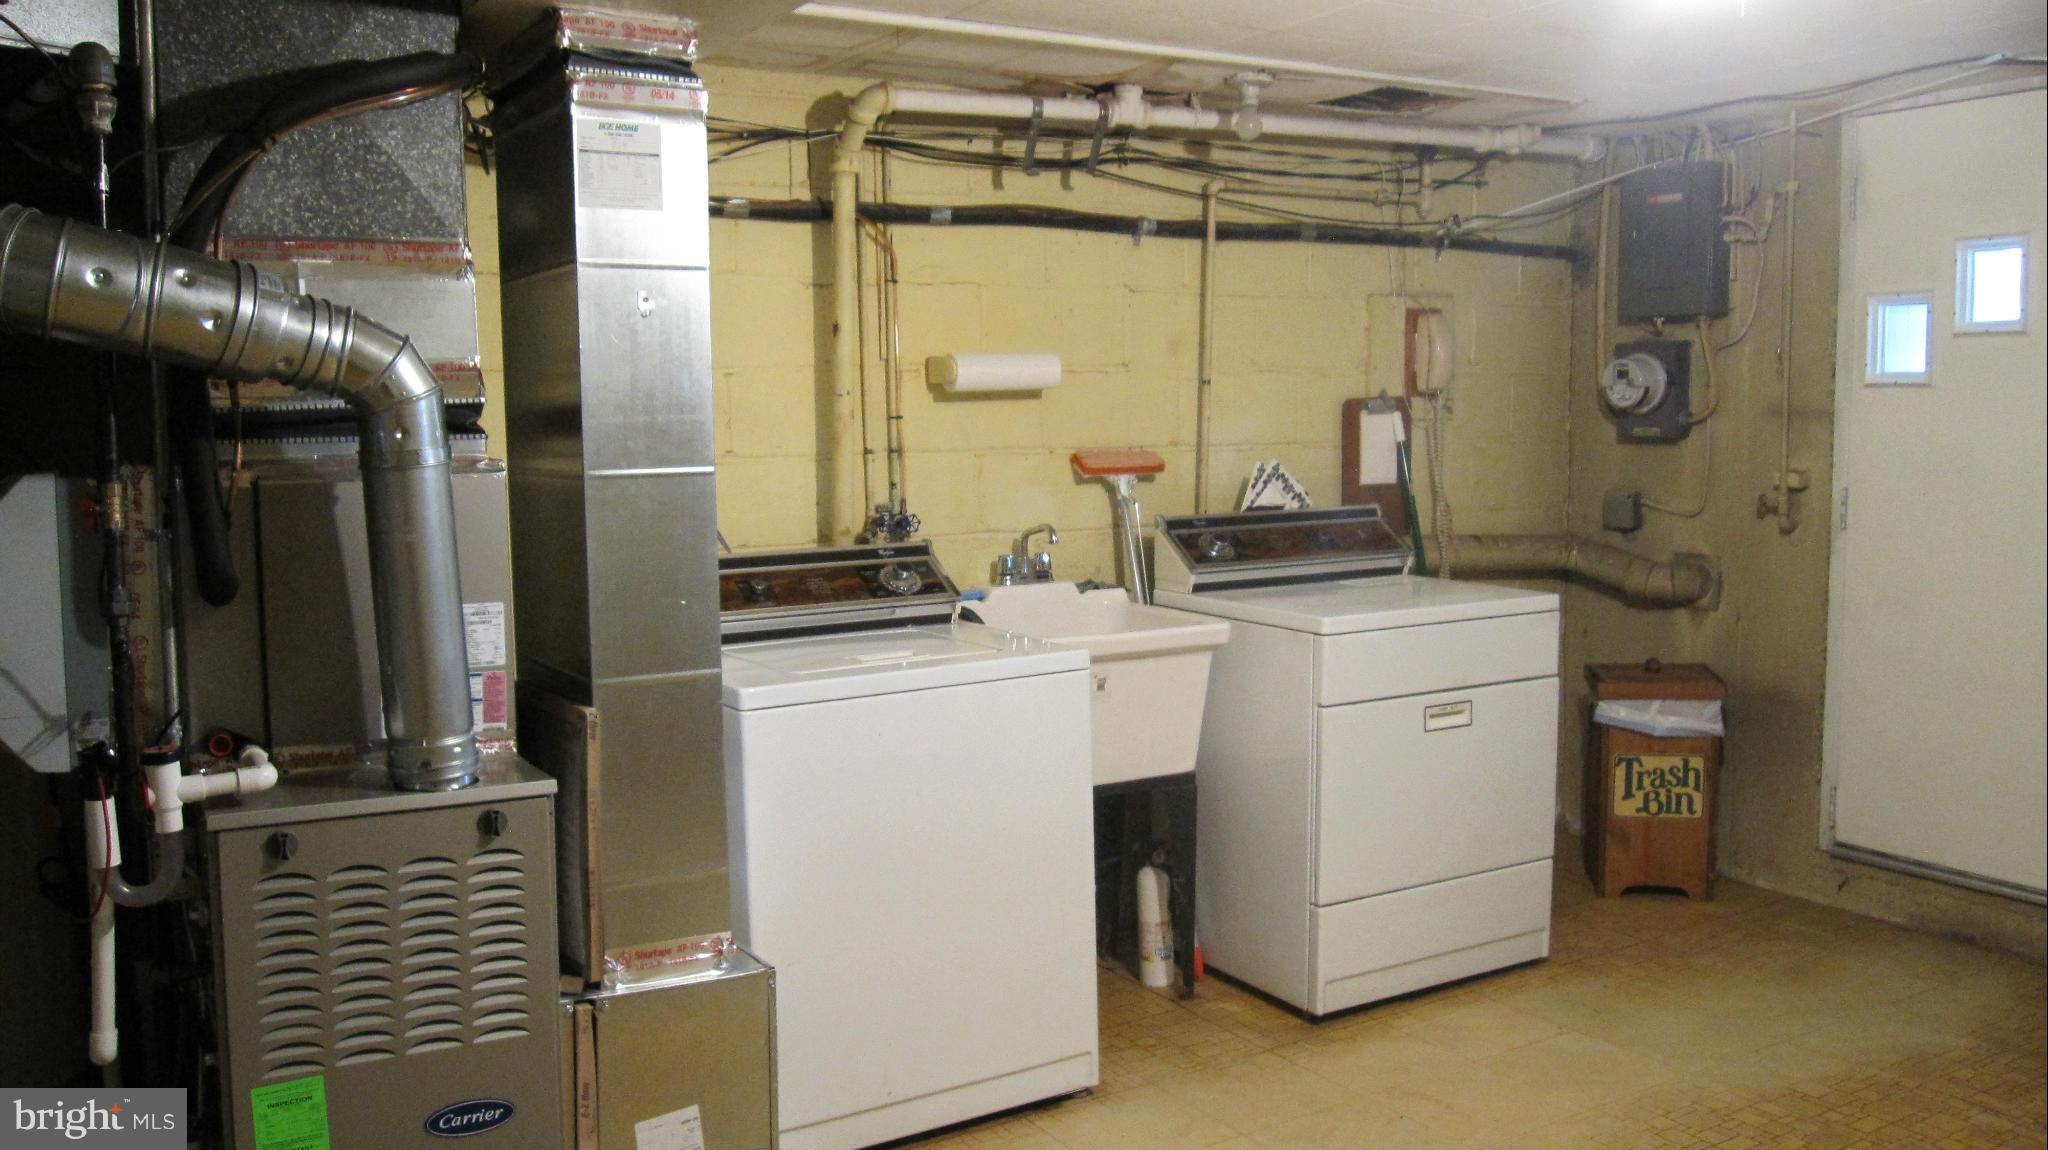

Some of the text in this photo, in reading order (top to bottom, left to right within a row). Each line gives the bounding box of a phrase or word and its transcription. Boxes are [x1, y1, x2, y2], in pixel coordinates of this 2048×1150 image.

[615, 124, 639, 132] HOME
[1616, 756, 1703, 801] Trash
[1635, 787, 1697, 816] Bin
[267, 1095, 313, 1109] INSPECTION
[439, 1108, 504, 1129] Carrier
